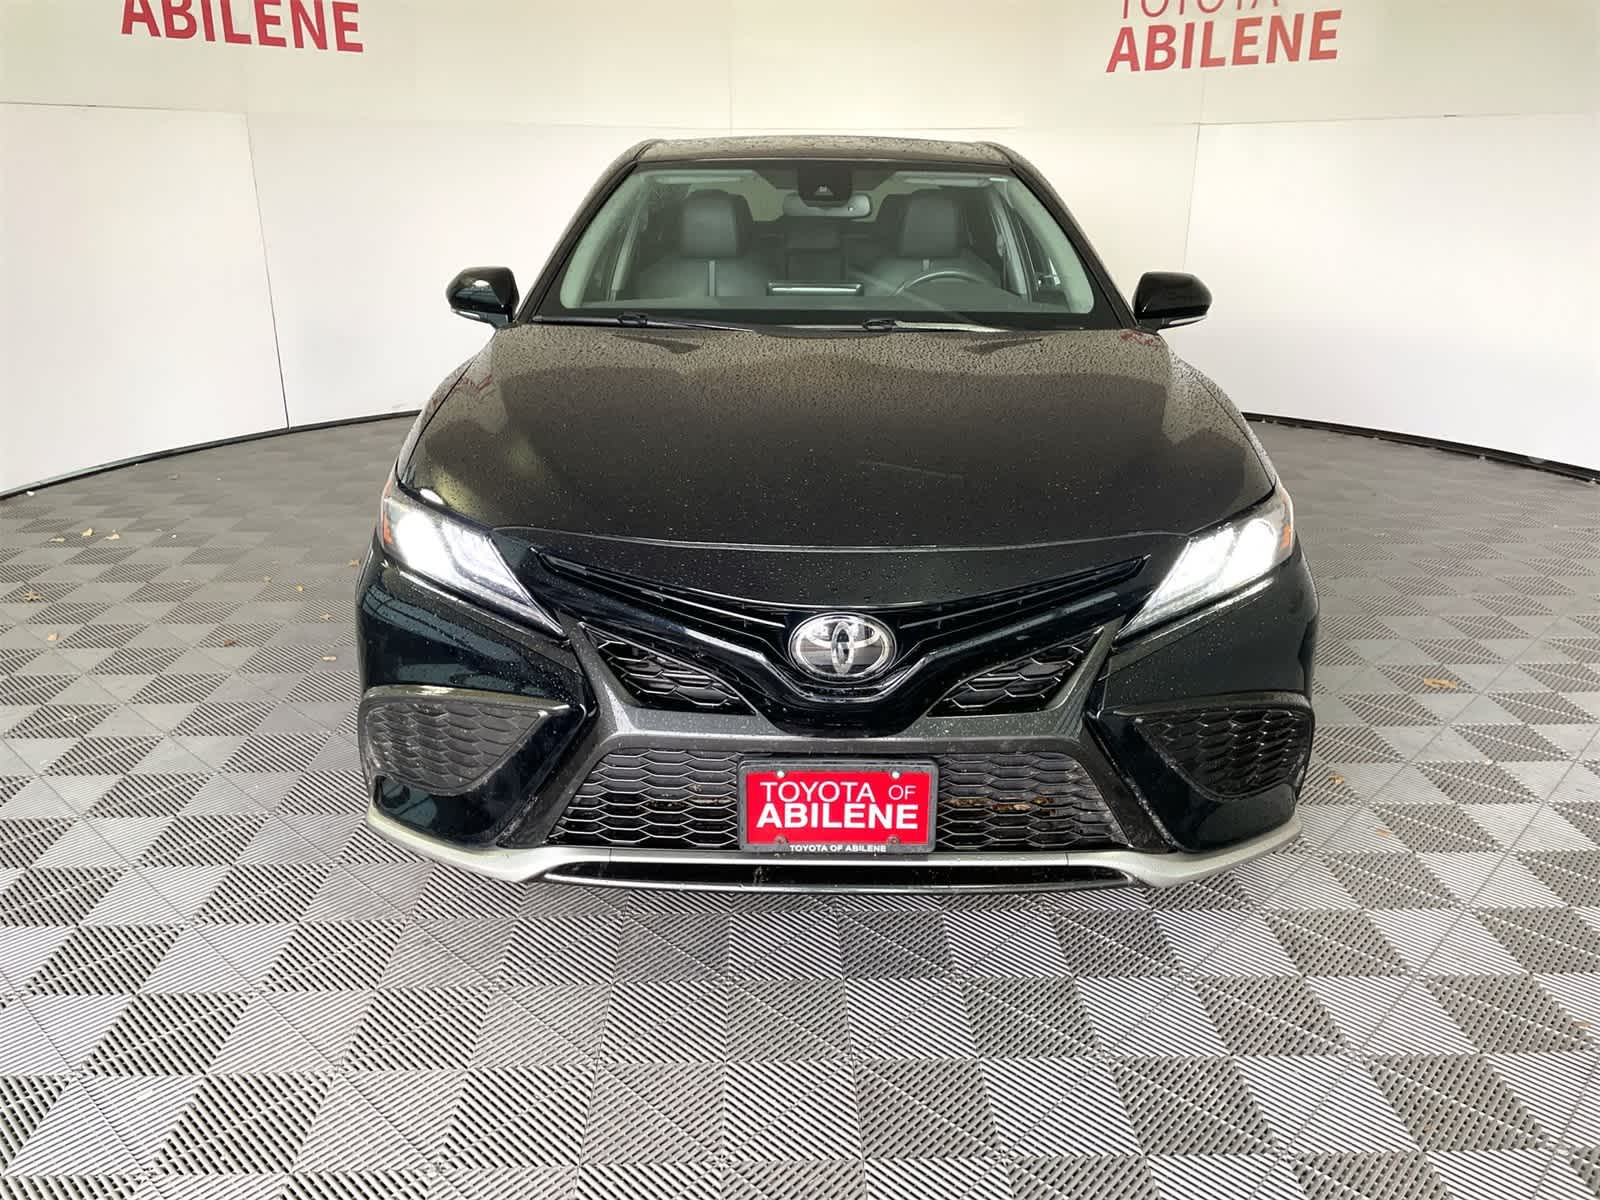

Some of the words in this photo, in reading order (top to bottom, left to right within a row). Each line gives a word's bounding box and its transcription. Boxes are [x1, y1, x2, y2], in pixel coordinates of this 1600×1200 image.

[121, 0, 364, 53] ABILENE
[1105, 10, 1342, 73] ABILENE
[759, 781, 876, 803] TOYOTA
[888, 785, 917, 800] OF
[756, 803, 918, 829] ABILENE
[789, 844, 828, 852] TOYOTA
[829, 844, 843, 852] OF
[844, 844, 887, 852] ABILENE
